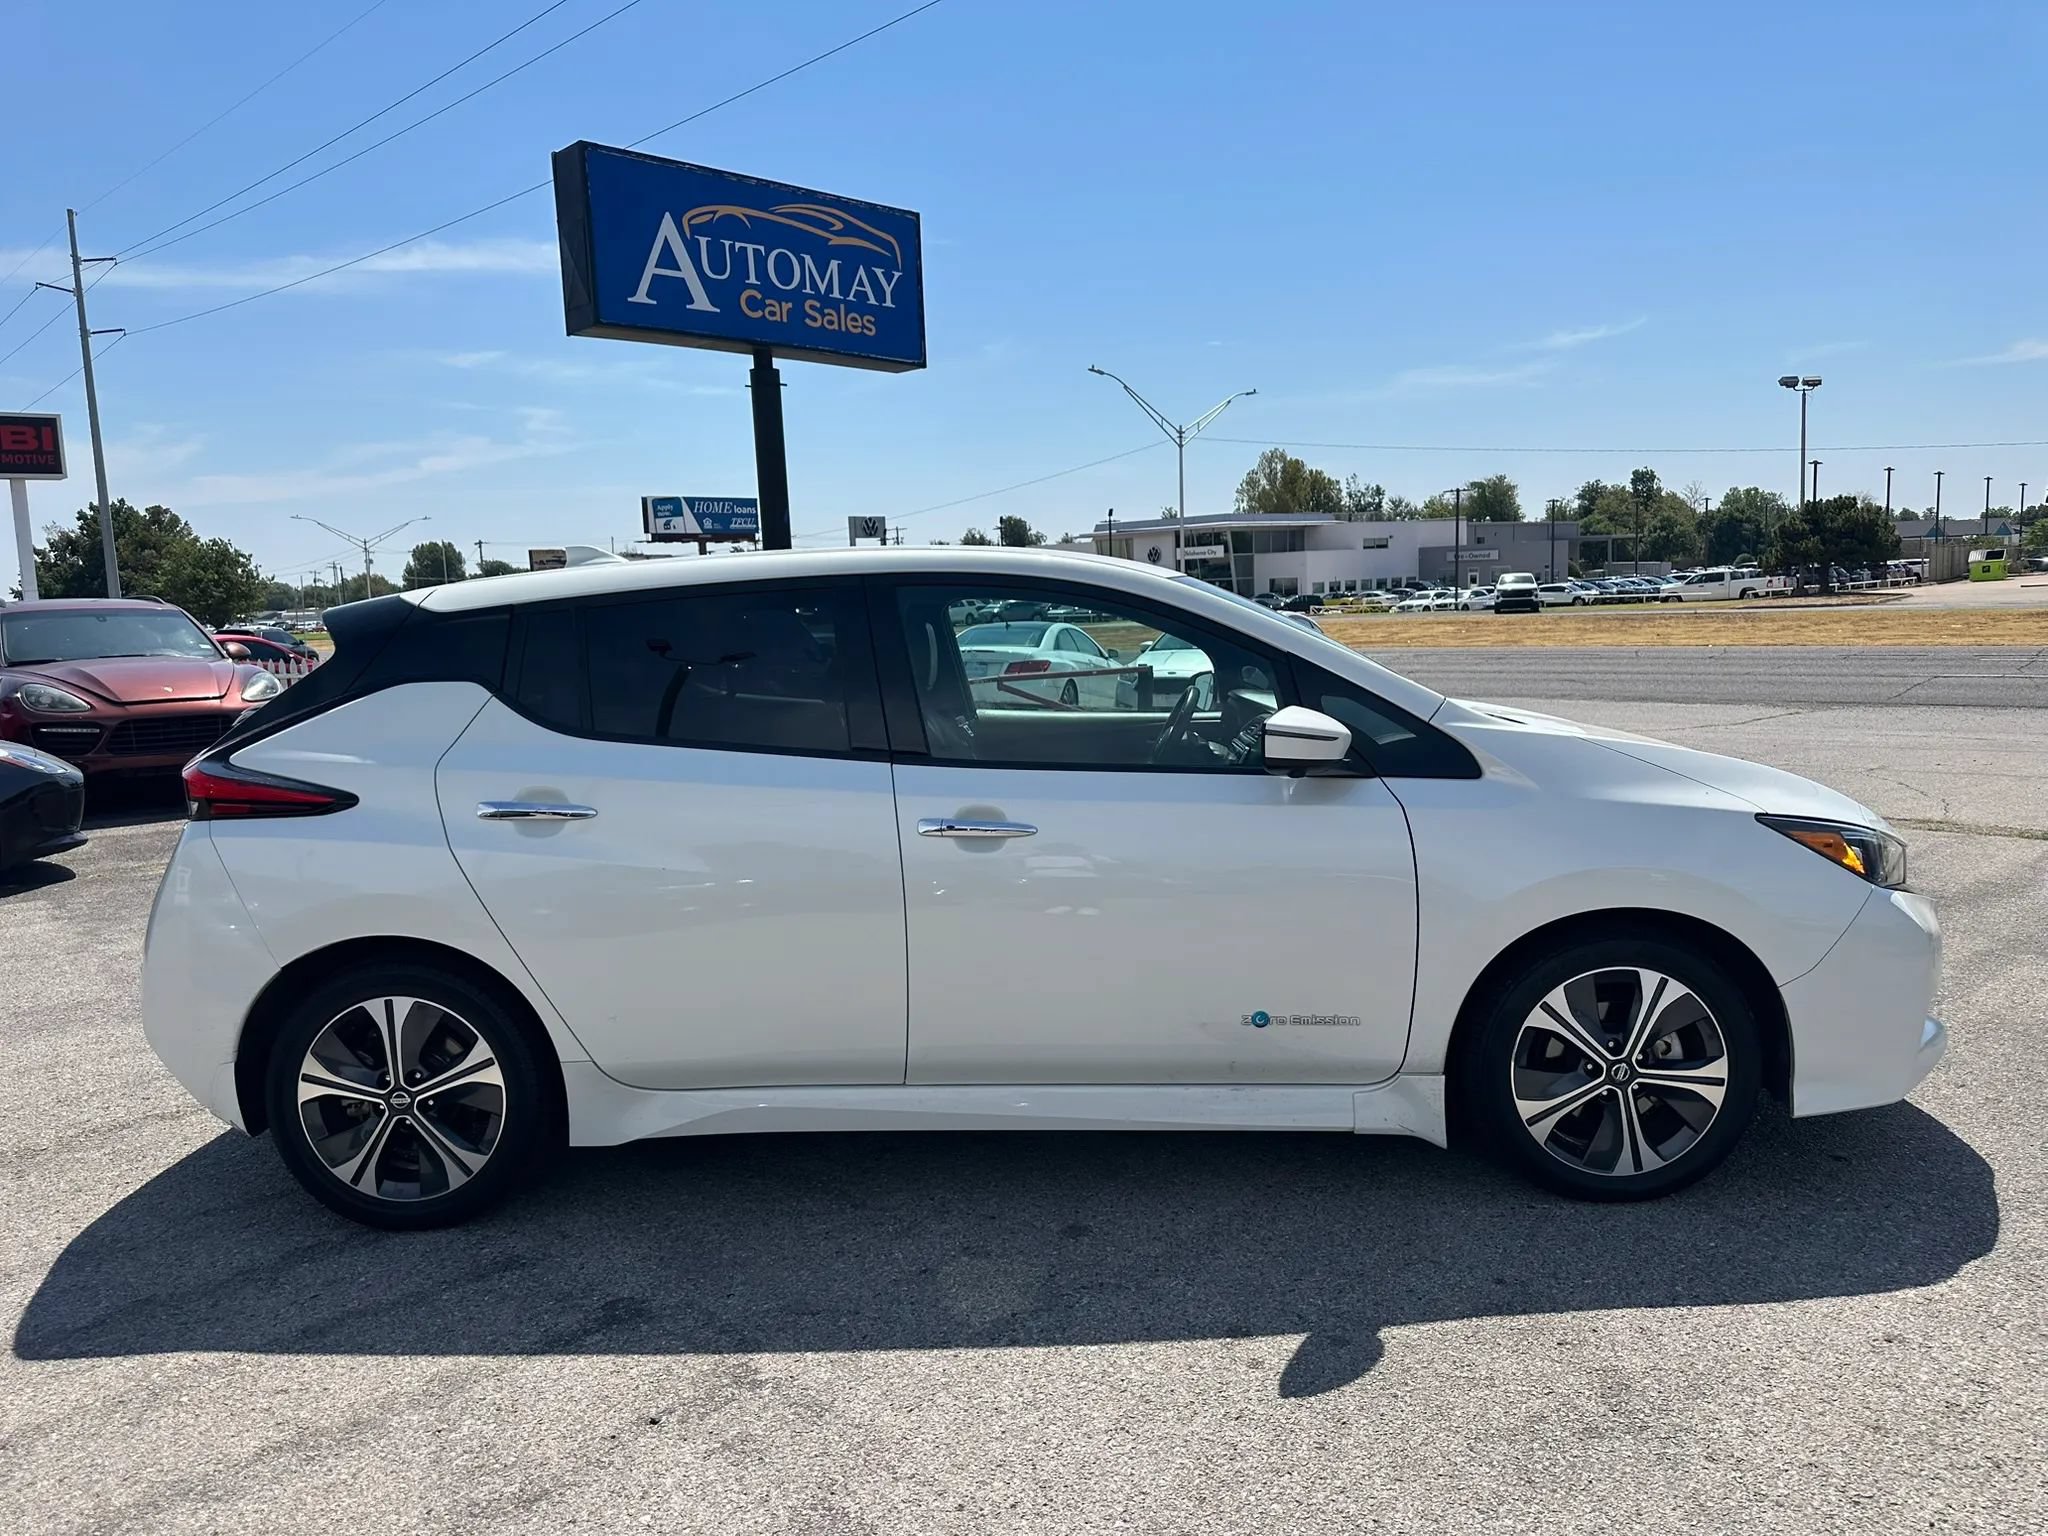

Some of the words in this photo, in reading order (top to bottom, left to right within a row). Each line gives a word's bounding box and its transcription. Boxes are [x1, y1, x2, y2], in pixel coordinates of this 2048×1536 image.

[627, 211, 903, 313] AUTOMAY
[739, 289, 793, 324] Car
[804, 299, 877, 337] Sales
[657, 504, 673, 512] Apply
[694, 501, 733, 514] HOME
[734, 505, 757, 514] loans
[1290, 1014, 1361, 1026] Emission
